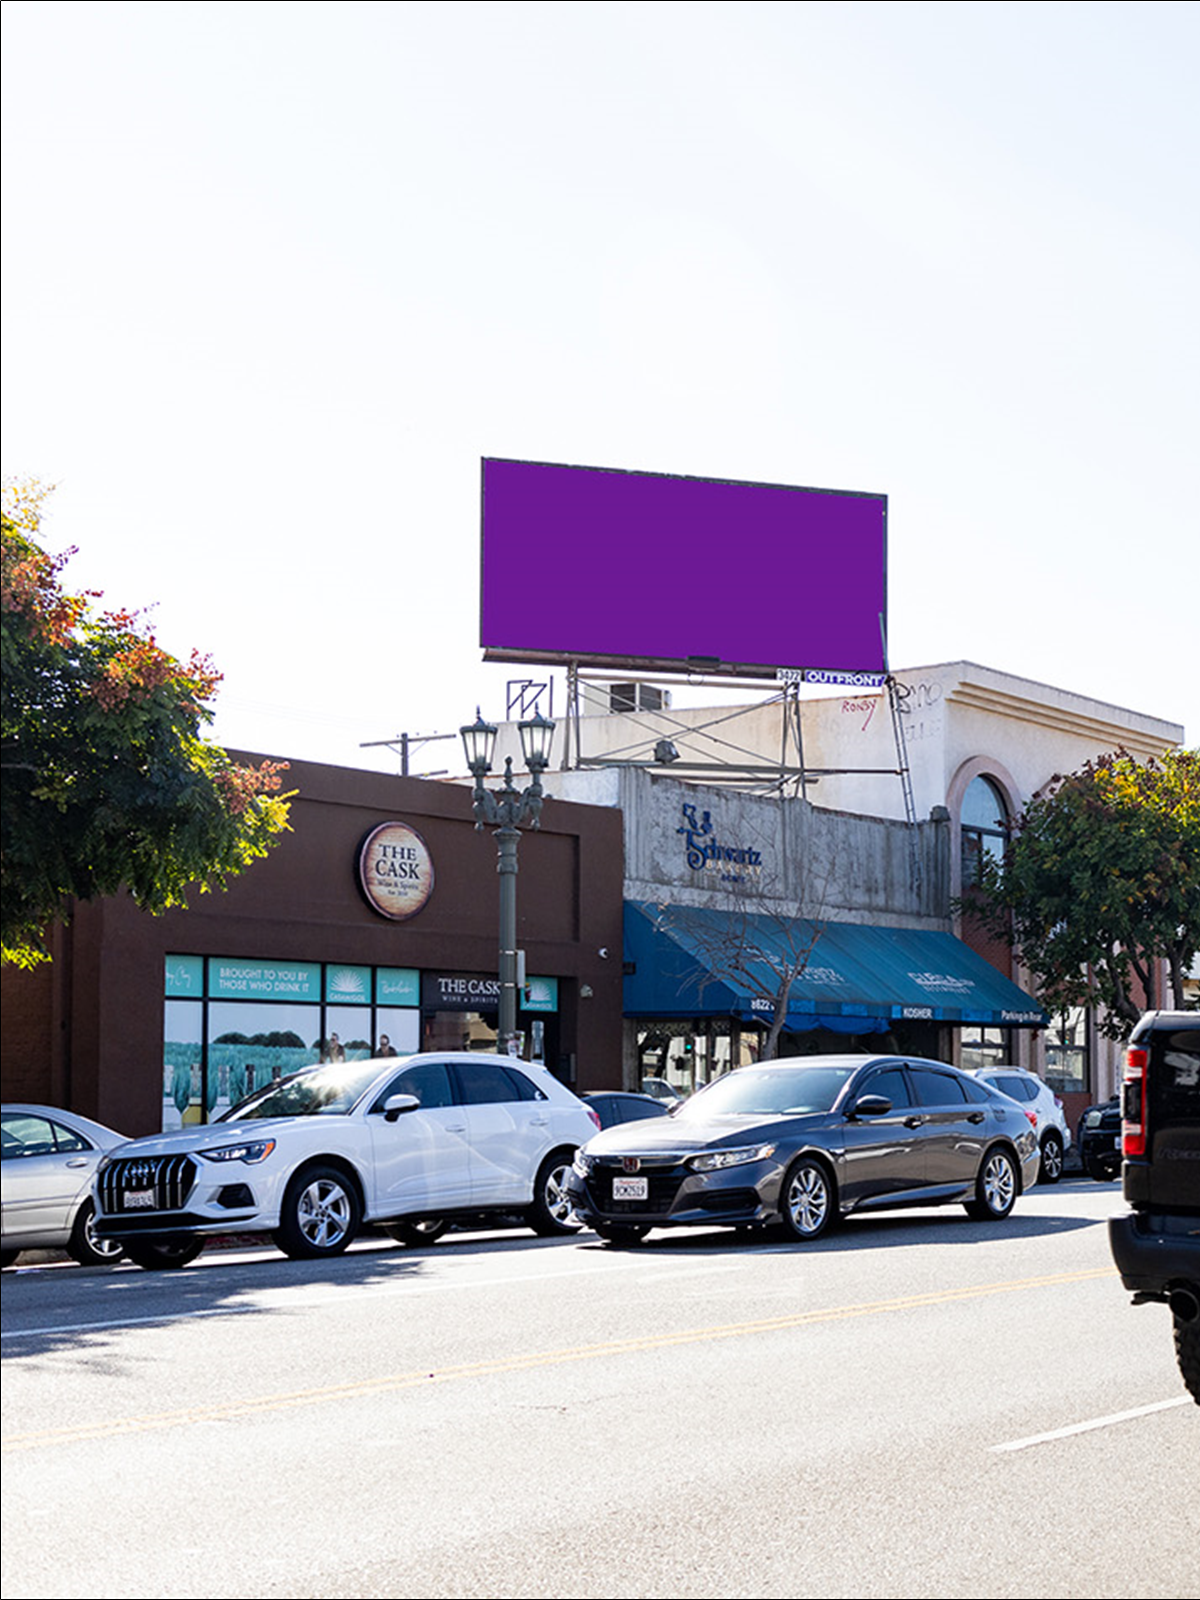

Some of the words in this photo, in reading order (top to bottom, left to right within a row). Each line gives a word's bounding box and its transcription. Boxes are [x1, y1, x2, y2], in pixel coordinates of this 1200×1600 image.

[807, 670, 884, 687] OUTFRONT
[378, 844, 417, 861] THE
[684, 832, 762, 871] Schwartz
[375, 859, 421, 880] CASK
[220, 967, 261, 979] BROUGHT
[264, 968, 275, 979] TO
[277, 969, 297, 981] YOU
[297, 971, 309, 982] BY
[219, 978, 247, 990] THOSE
[249, 980, 272, 991] WHO
[274, 981, 301, 993] DRINK
[302, 982, 310, 993] IT
[438, 978, 467, 993] THE
[468, 979, 501, 994] CASK
[903, 1007, 933, 1019] KOSHER
[1001, 1010, 1023, 1022] Parking
